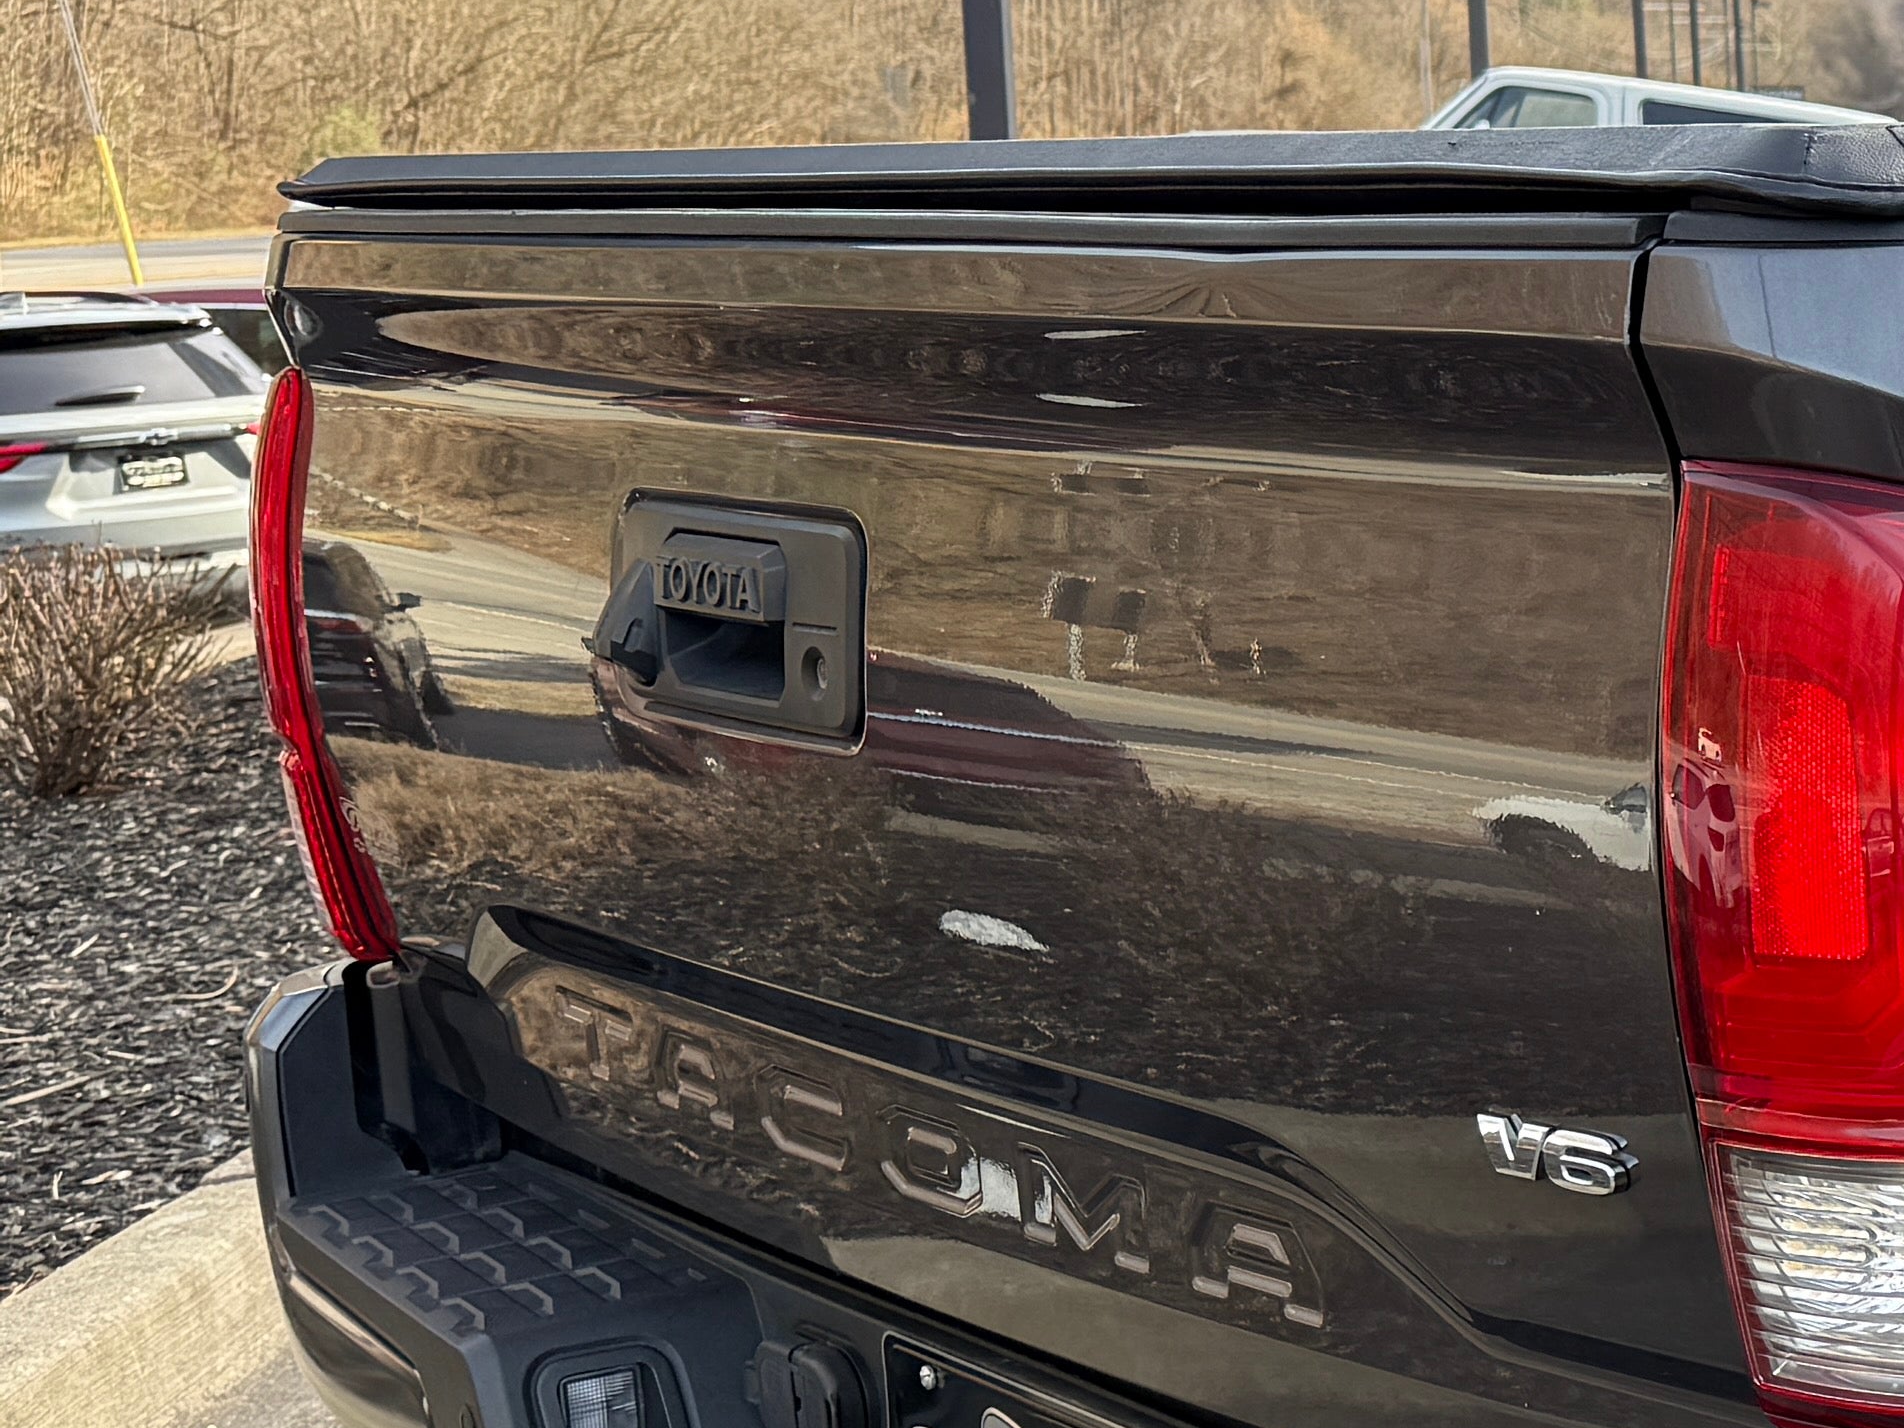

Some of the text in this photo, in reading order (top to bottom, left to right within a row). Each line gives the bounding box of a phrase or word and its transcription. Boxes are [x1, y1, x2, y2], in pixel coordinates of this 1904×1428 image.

[653, 555, 763, 614] TOYOTA
[552, 982, 1328, 1329] TACOMA
[1476, 1113, 1640, 1196] V6
